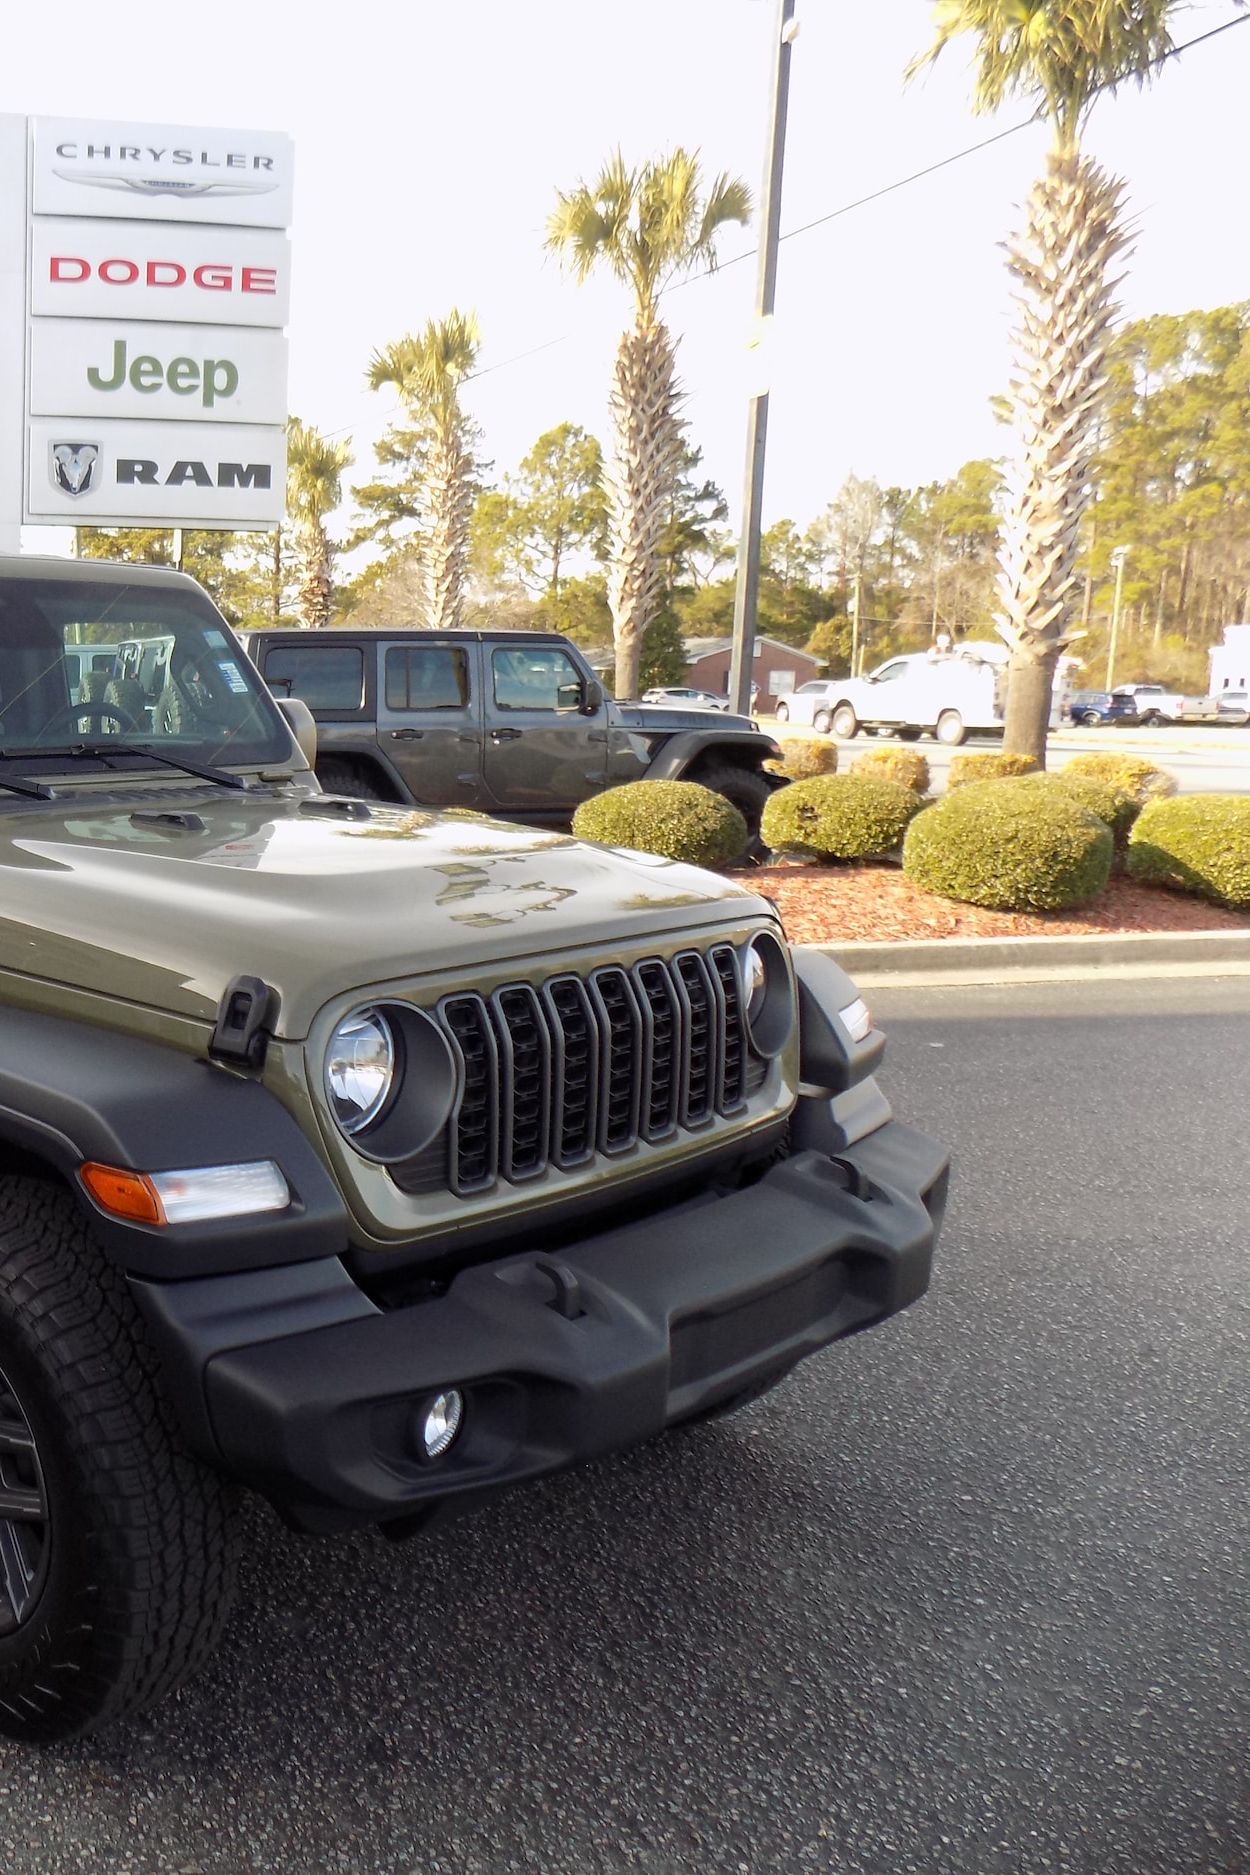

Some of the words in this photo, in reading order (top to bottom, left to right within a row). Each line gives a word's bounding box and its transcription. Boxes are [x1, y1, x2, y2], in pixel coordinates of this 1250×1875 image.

[55, 143, 275, 171] CHRYSLER
[50, 256, 278, 295] DODGE
[86, 339, 240, 408] Jeep
[116, 458, 271, 489] RAM
